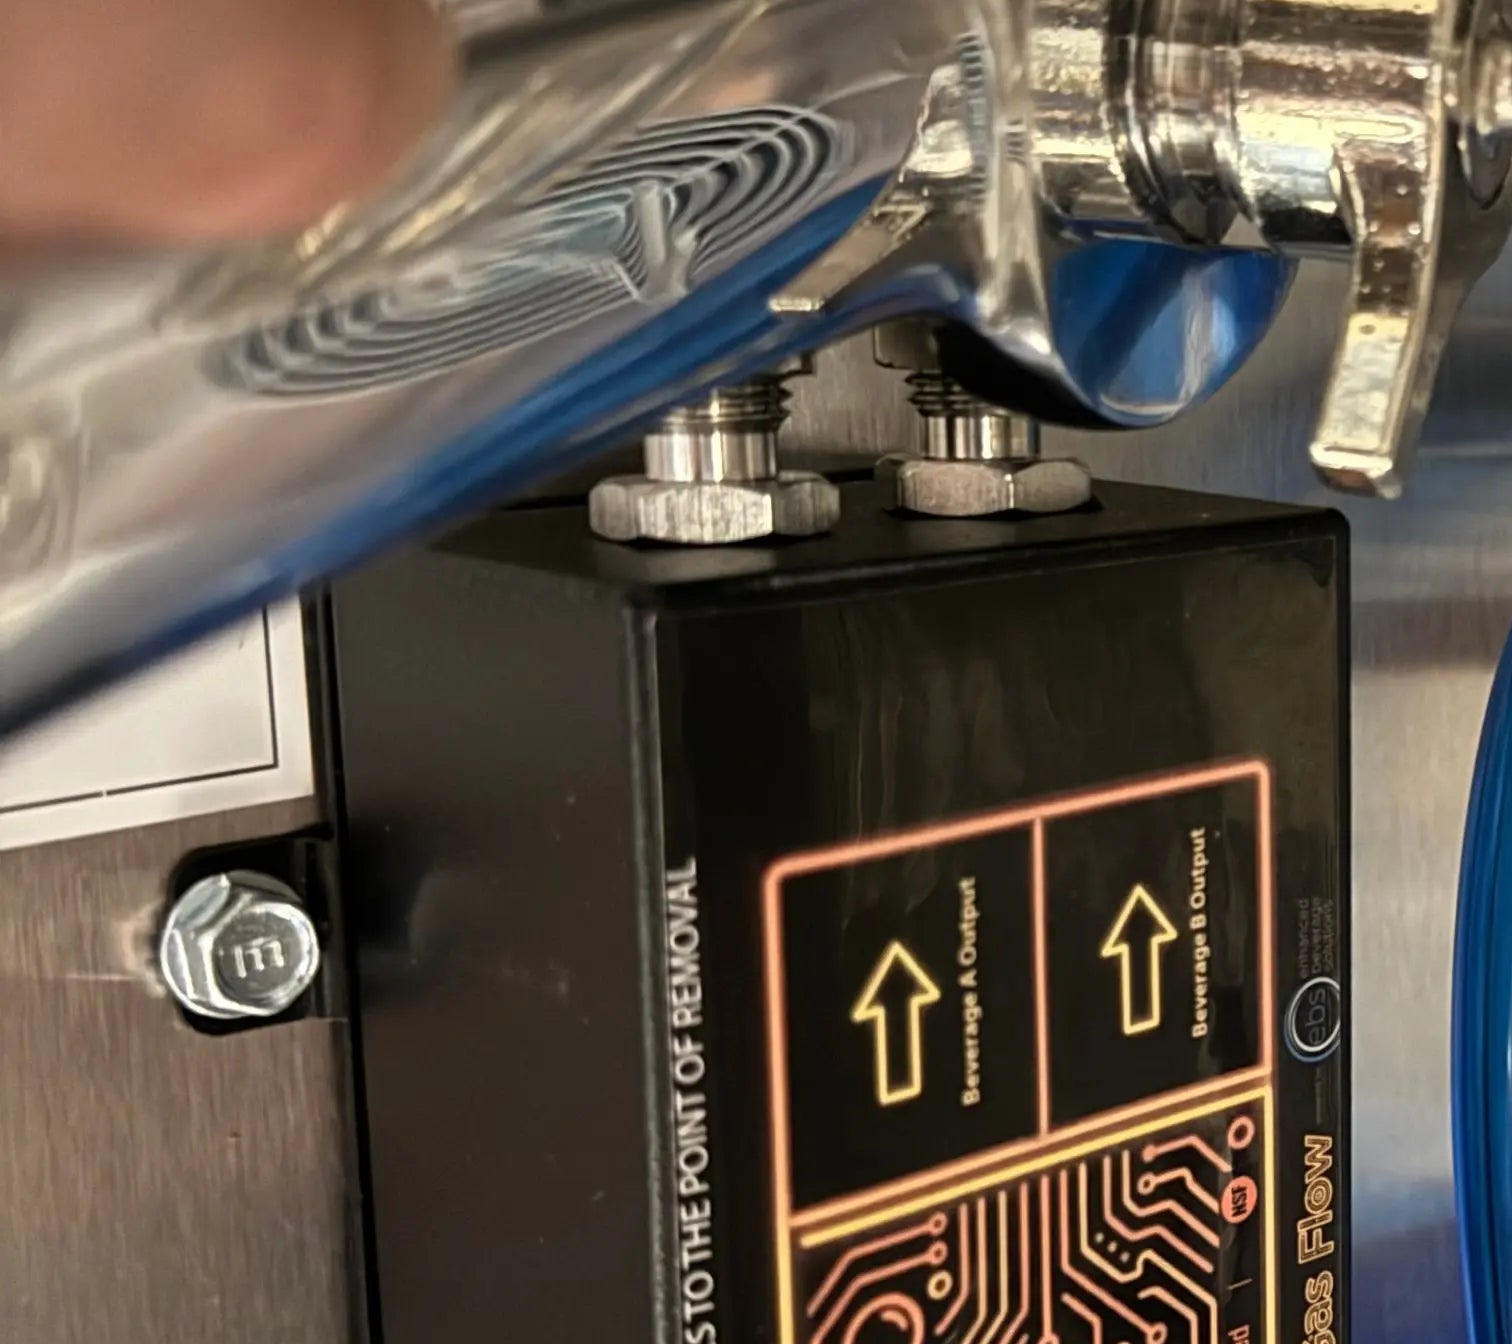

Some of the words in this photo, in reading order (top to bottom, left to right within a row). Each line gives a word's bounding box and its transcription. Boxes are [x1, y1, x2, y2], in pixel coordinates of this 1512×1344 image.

[1188, 827, 1209, 908] Output
[666, 856, 702, 1027] REMOVAL
[958, 876, 981, 965] Output
[1191, 913, 1207, 927] B
[959, 969, 978, 986] A
[1191, 931, 1210, 1037] Beverage
[1304, 988, 1326, 1044] ebs
[672, 1034, 704, 1084] OF
[960, 991, 981, 1105] Beverage
[674, 1091, 708, 1194] POINT
[677, 1198, 711, 1267] THE
[1297, 1134, 1333, 1264] Flow
[683, 1269, 714, 1321] TO
